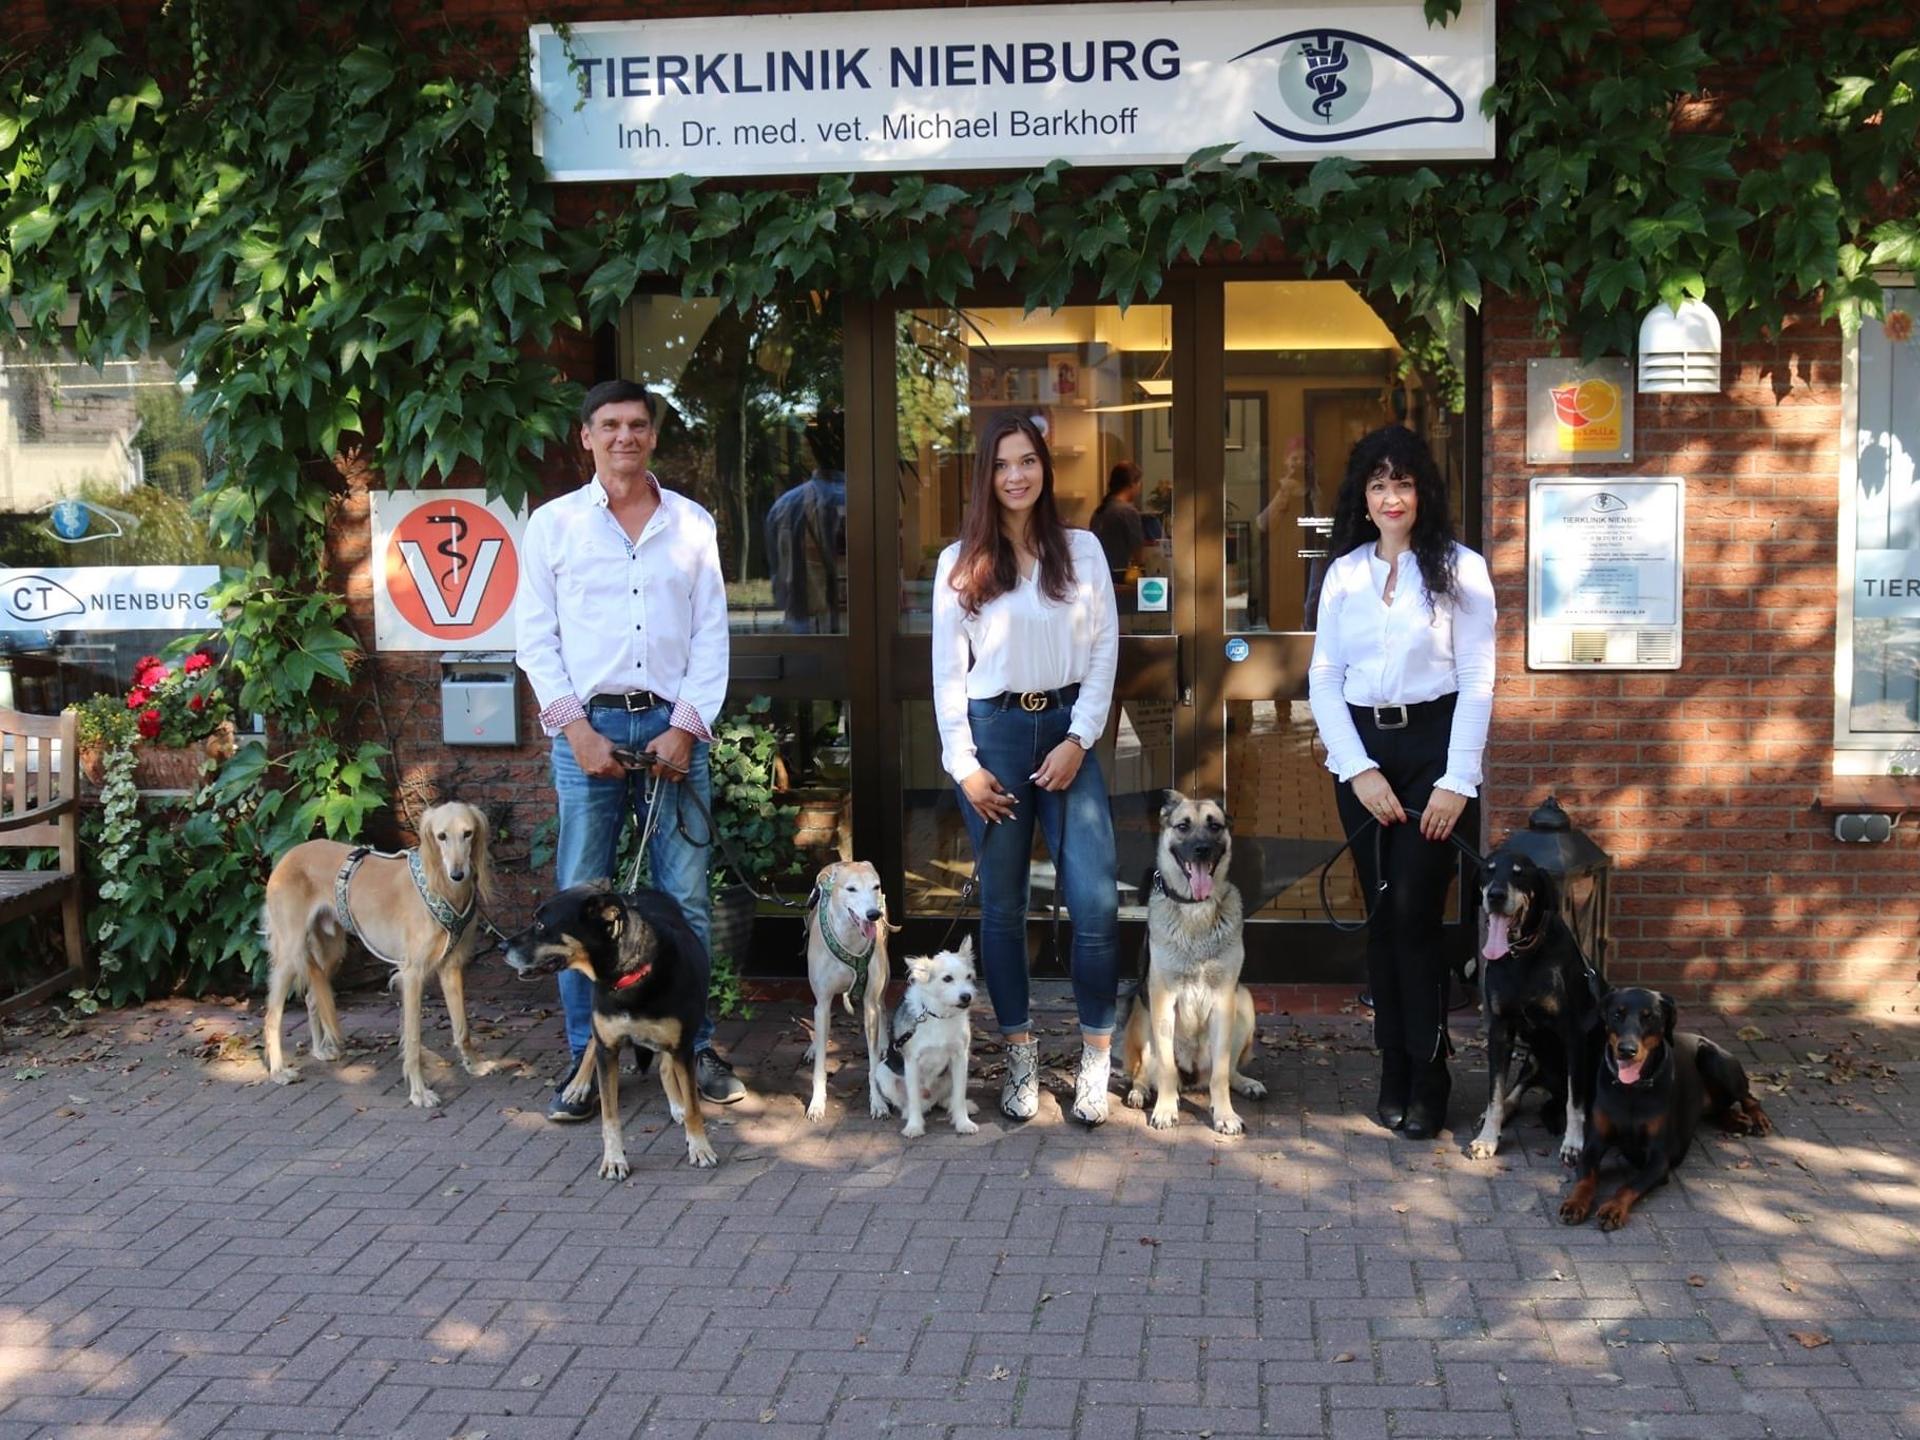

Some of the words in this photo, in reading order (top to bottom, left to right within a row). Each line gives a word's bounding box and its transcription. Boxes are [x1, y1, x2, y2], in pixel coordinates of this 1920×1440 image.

[576, 47, 872, 99] TIERKLINIK
[889, 38, 1181, 88] NIENBURG
[618, 122, 670, 149] Inh.
[682, 120, 722, 147] Dr.
[734, 118, 805, 145] med.
[817, 117, 870, 142] vet.
[882, 111, 998, 141] Michael
[1009, 107, 1139, 137] Barkhoff
[1562, 516, 1607, 524] TIERKLINIK
[1608, 516, 1644, 524] NIENBU
[1863, 578, 1920, 597] TIER
[13, 587, 53, 612] CT
[91, 592, 209, 611] NIENBURG
